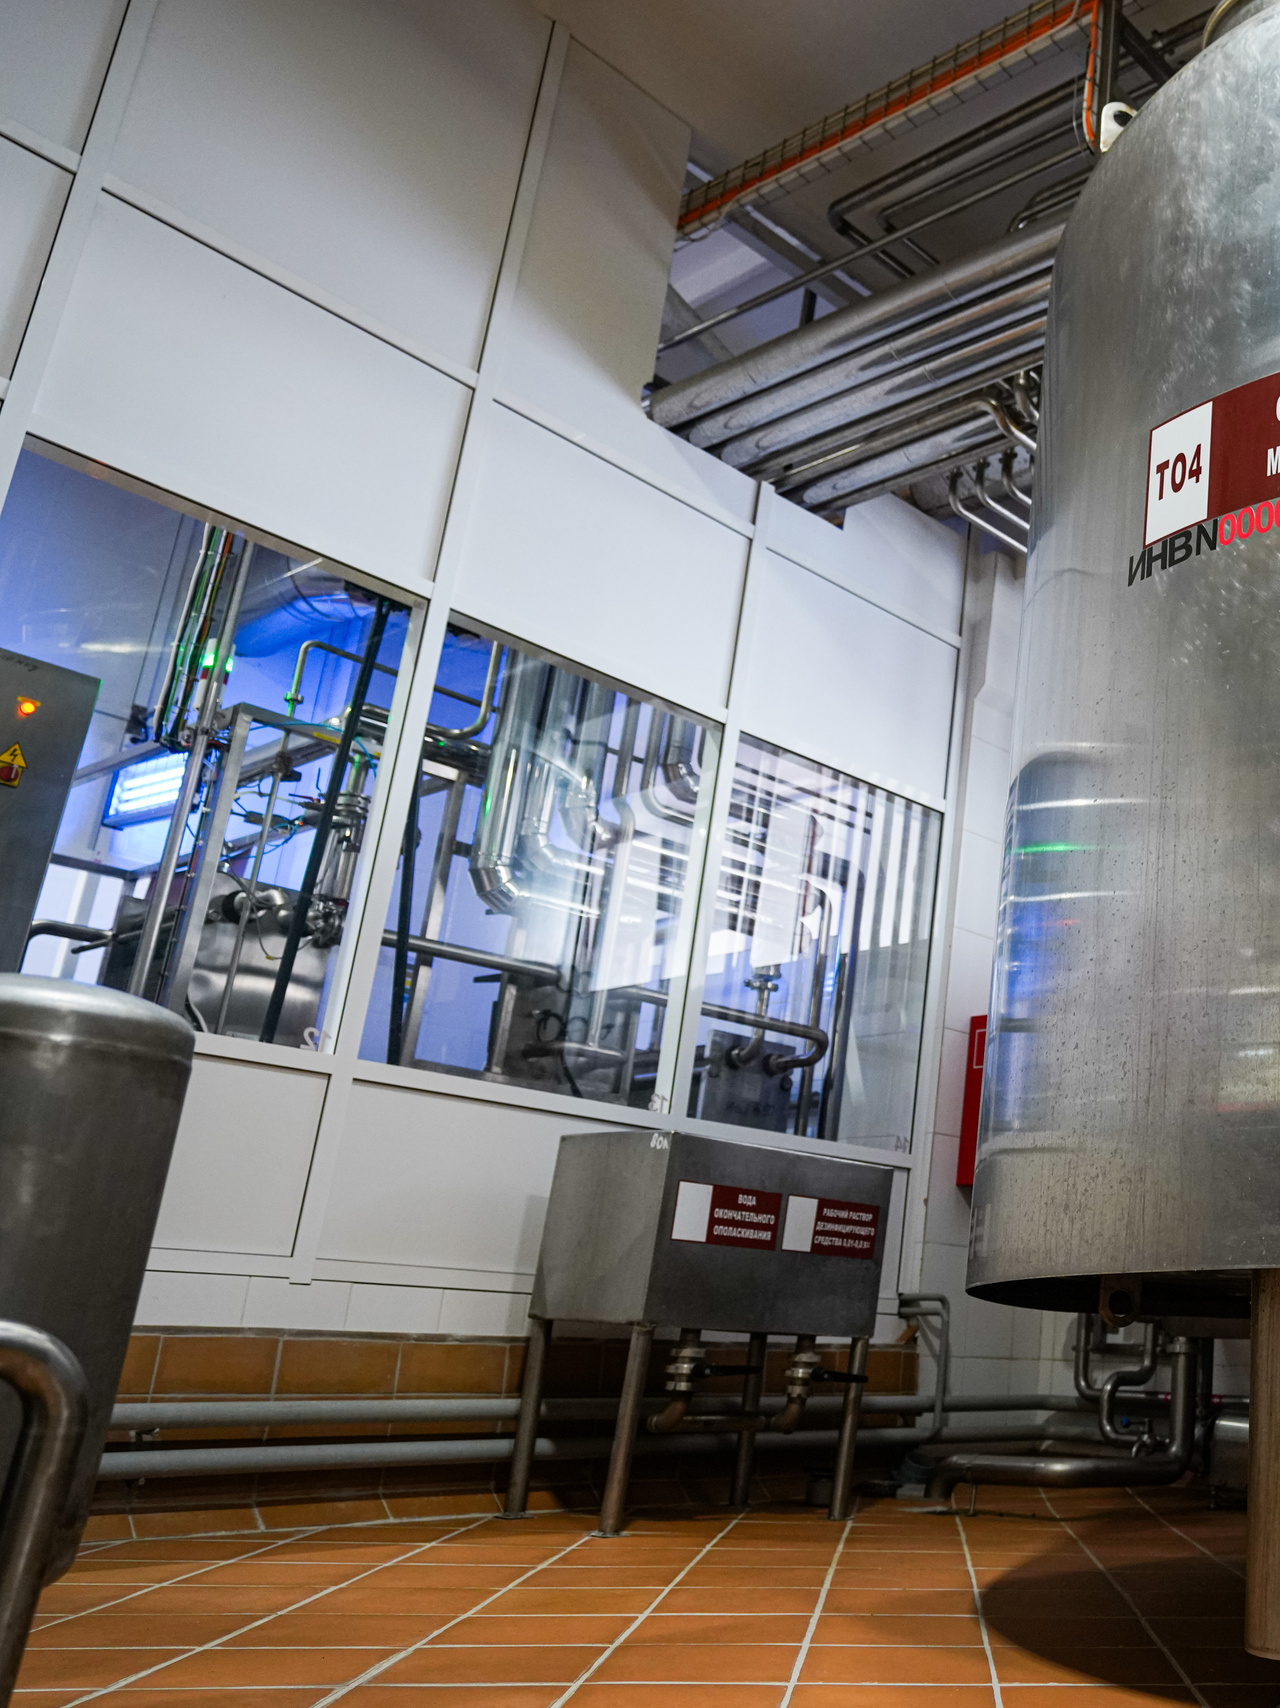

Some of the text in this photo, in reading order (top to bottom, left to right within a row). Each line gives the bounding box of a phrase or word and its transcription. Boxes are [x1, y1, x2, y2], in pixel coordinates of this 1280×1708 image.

[738, 1194, 757, 1206] ВОДА
[713, 1207, 775, 1225] ОКОНЧАТЕЛЬНОГО
[823, 1208, 873, 1222] РАБОЧИЙ РАСТВОР
[713, 1224, 771, 1241] ОПОЛАСКИВАНИЯ
[815, 1221, 875, 1236] ДЕЗИНФИЦИРУЮЩЕГО
[813, 1235, 842, 1247] СРЕДСТВА
